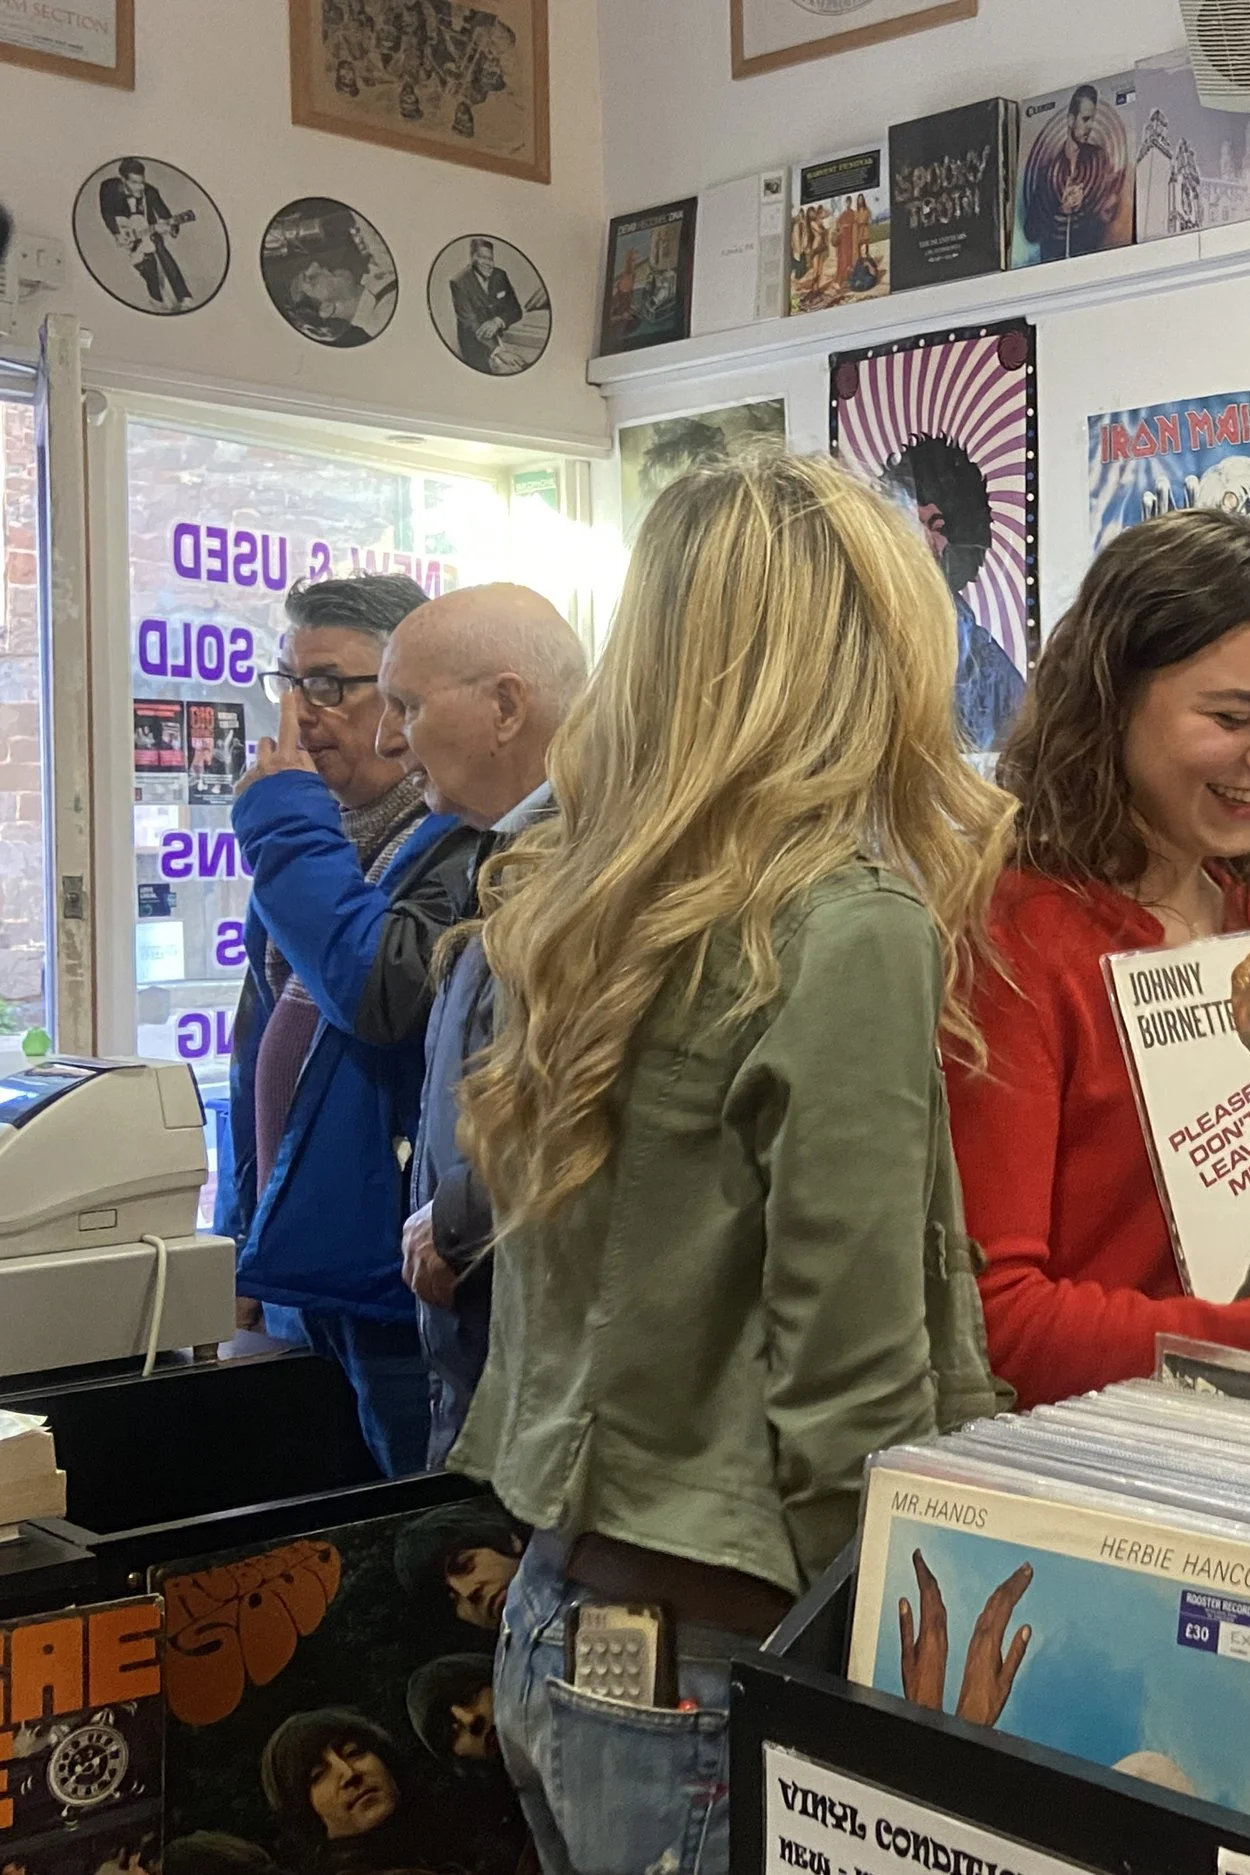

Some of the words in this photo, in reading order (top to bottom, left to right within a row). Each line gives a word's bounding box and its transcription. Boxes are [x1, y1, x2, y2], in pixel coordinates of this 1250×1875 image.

[1101, 412, 1182, 464] IRON
[1129, 961, 1205, 1007] JOHNNY
[1099, 1535, 1175, 1571] HERBIE
[1185, 1592, 1221, 1610] ROOSTER
[1185, 1622, 1210, 1642] £30
[0, 1604, 161, 1727] AE
[778, 1777, 866, 1841] VINYL
[875, 1817, 1023, 1875] CONDITI
[778, 1834, 831, 1875] NEW
